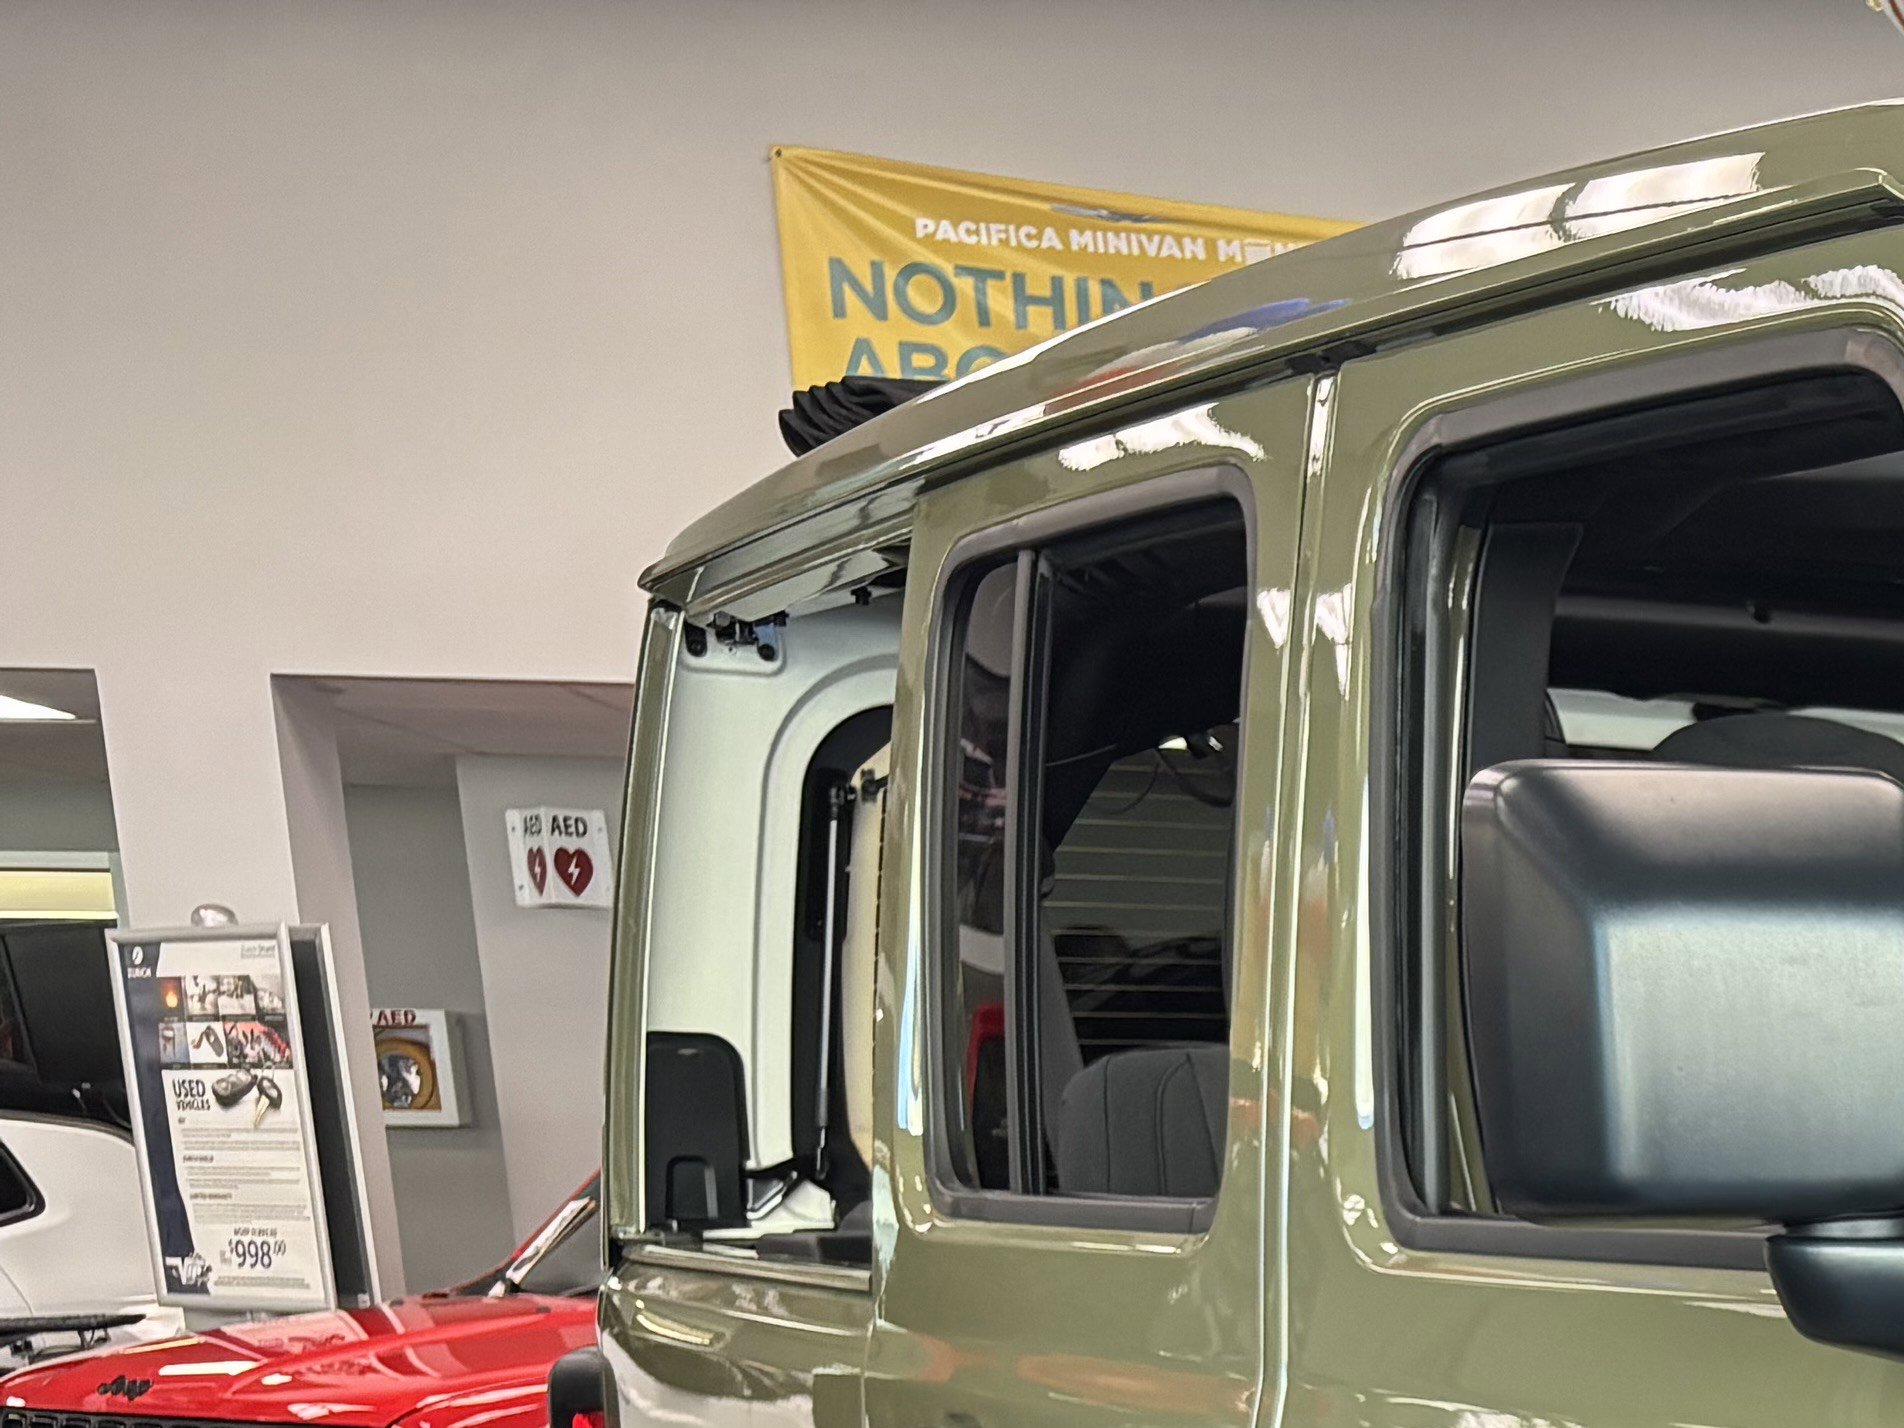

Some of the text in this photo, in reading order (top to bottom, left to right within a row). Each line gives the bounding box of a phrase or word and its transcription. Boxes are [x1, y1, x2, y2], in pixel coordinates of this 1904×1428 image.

[915, 217, 1064, 252] PACIFICA
[1069, 232, 1204, 261] MINIVAN
[551, 815, 587, 838] AED
[377, 1010, 416, 1026] AED
[172, 1079, 206, 1098] USED
[176, 1099, 211, 1111] VEHICLES
